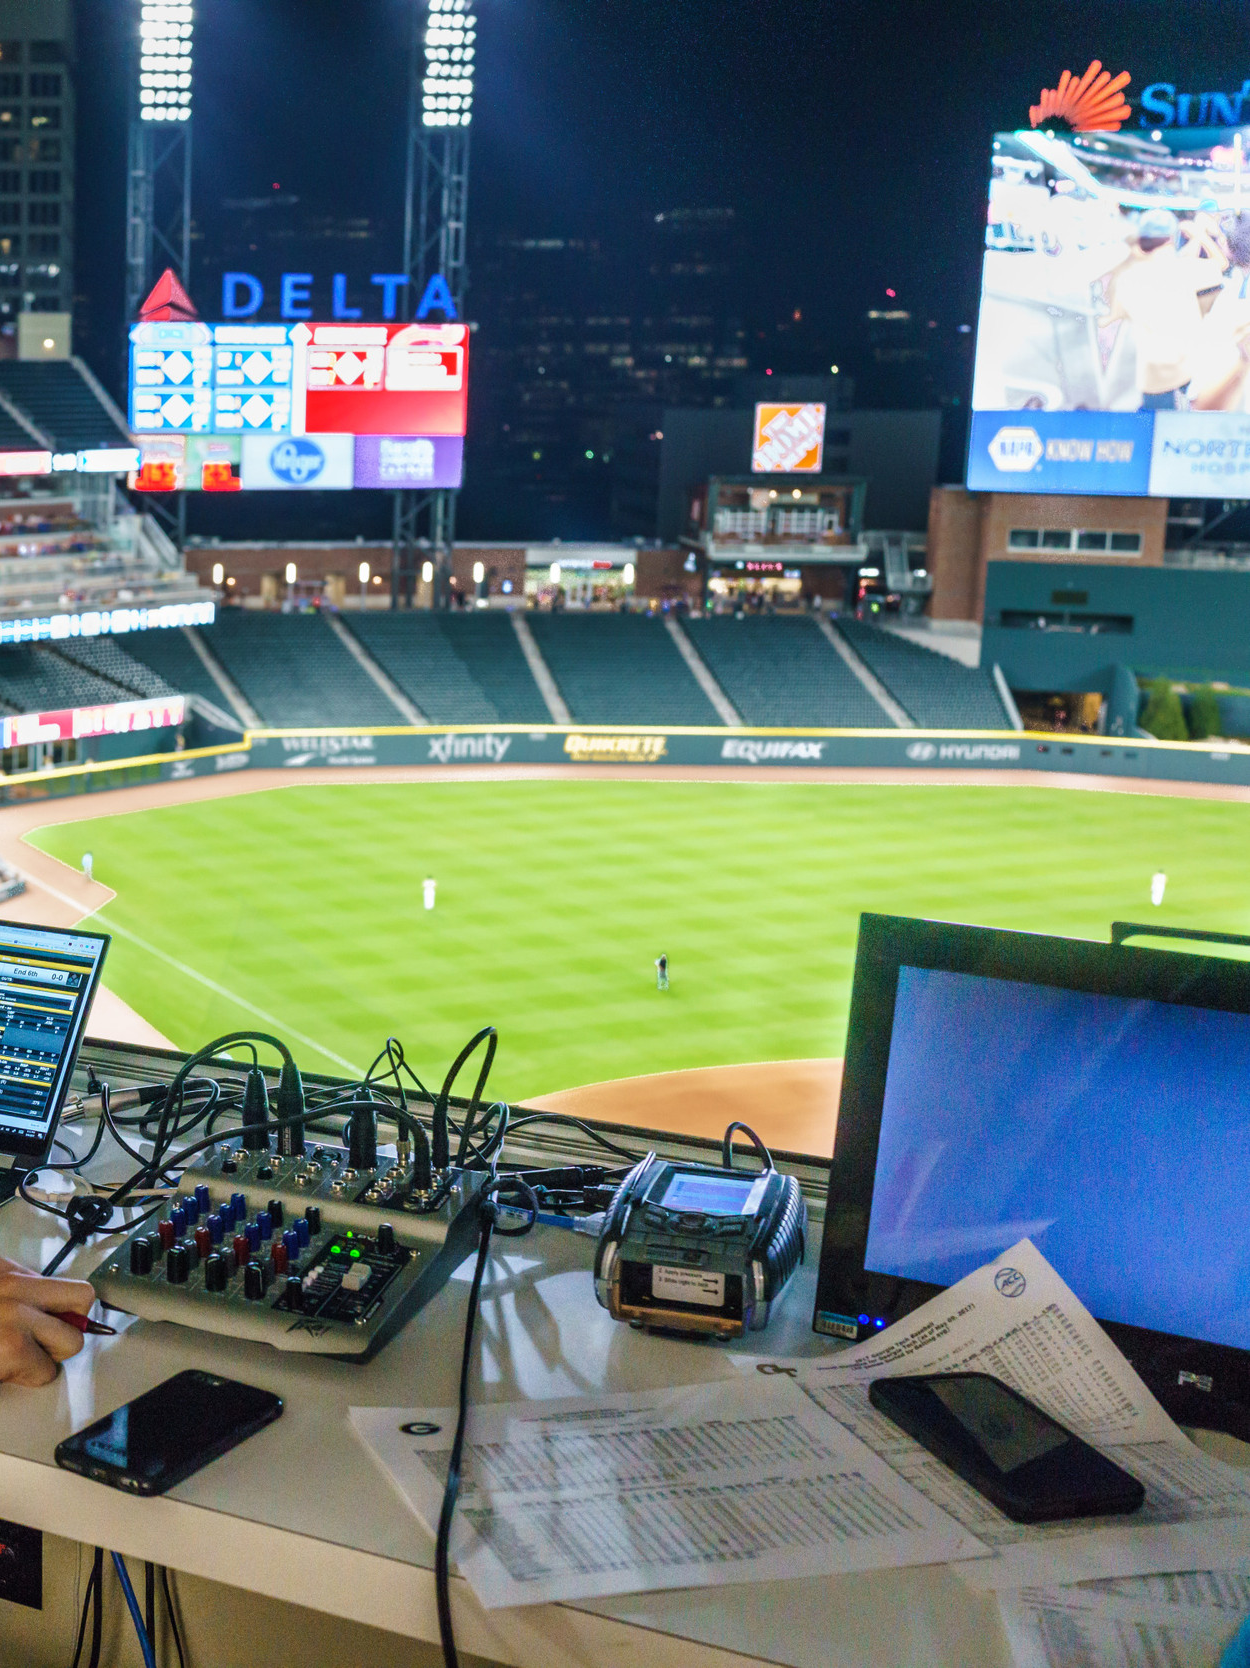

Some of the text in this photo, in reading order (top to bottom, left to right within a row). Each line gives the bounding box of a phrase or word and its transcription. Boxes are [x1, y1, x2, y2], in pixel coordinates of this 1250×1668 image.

[221, 271, 459, 320] DELTA
[1045, 439, 1094, 462] KNOW
[1096, 440, 1134, 463] HOW
[428, 733, 512, 762] xfinity
[721, 738, 825, 763] EQUIFAX
[939, 745, 1021, 760] HYUNDAI
[14, 968, 26, 976] End
[28, 969, 38, 977] 6th
[1002, 1272, 1021, 1288] ACC
